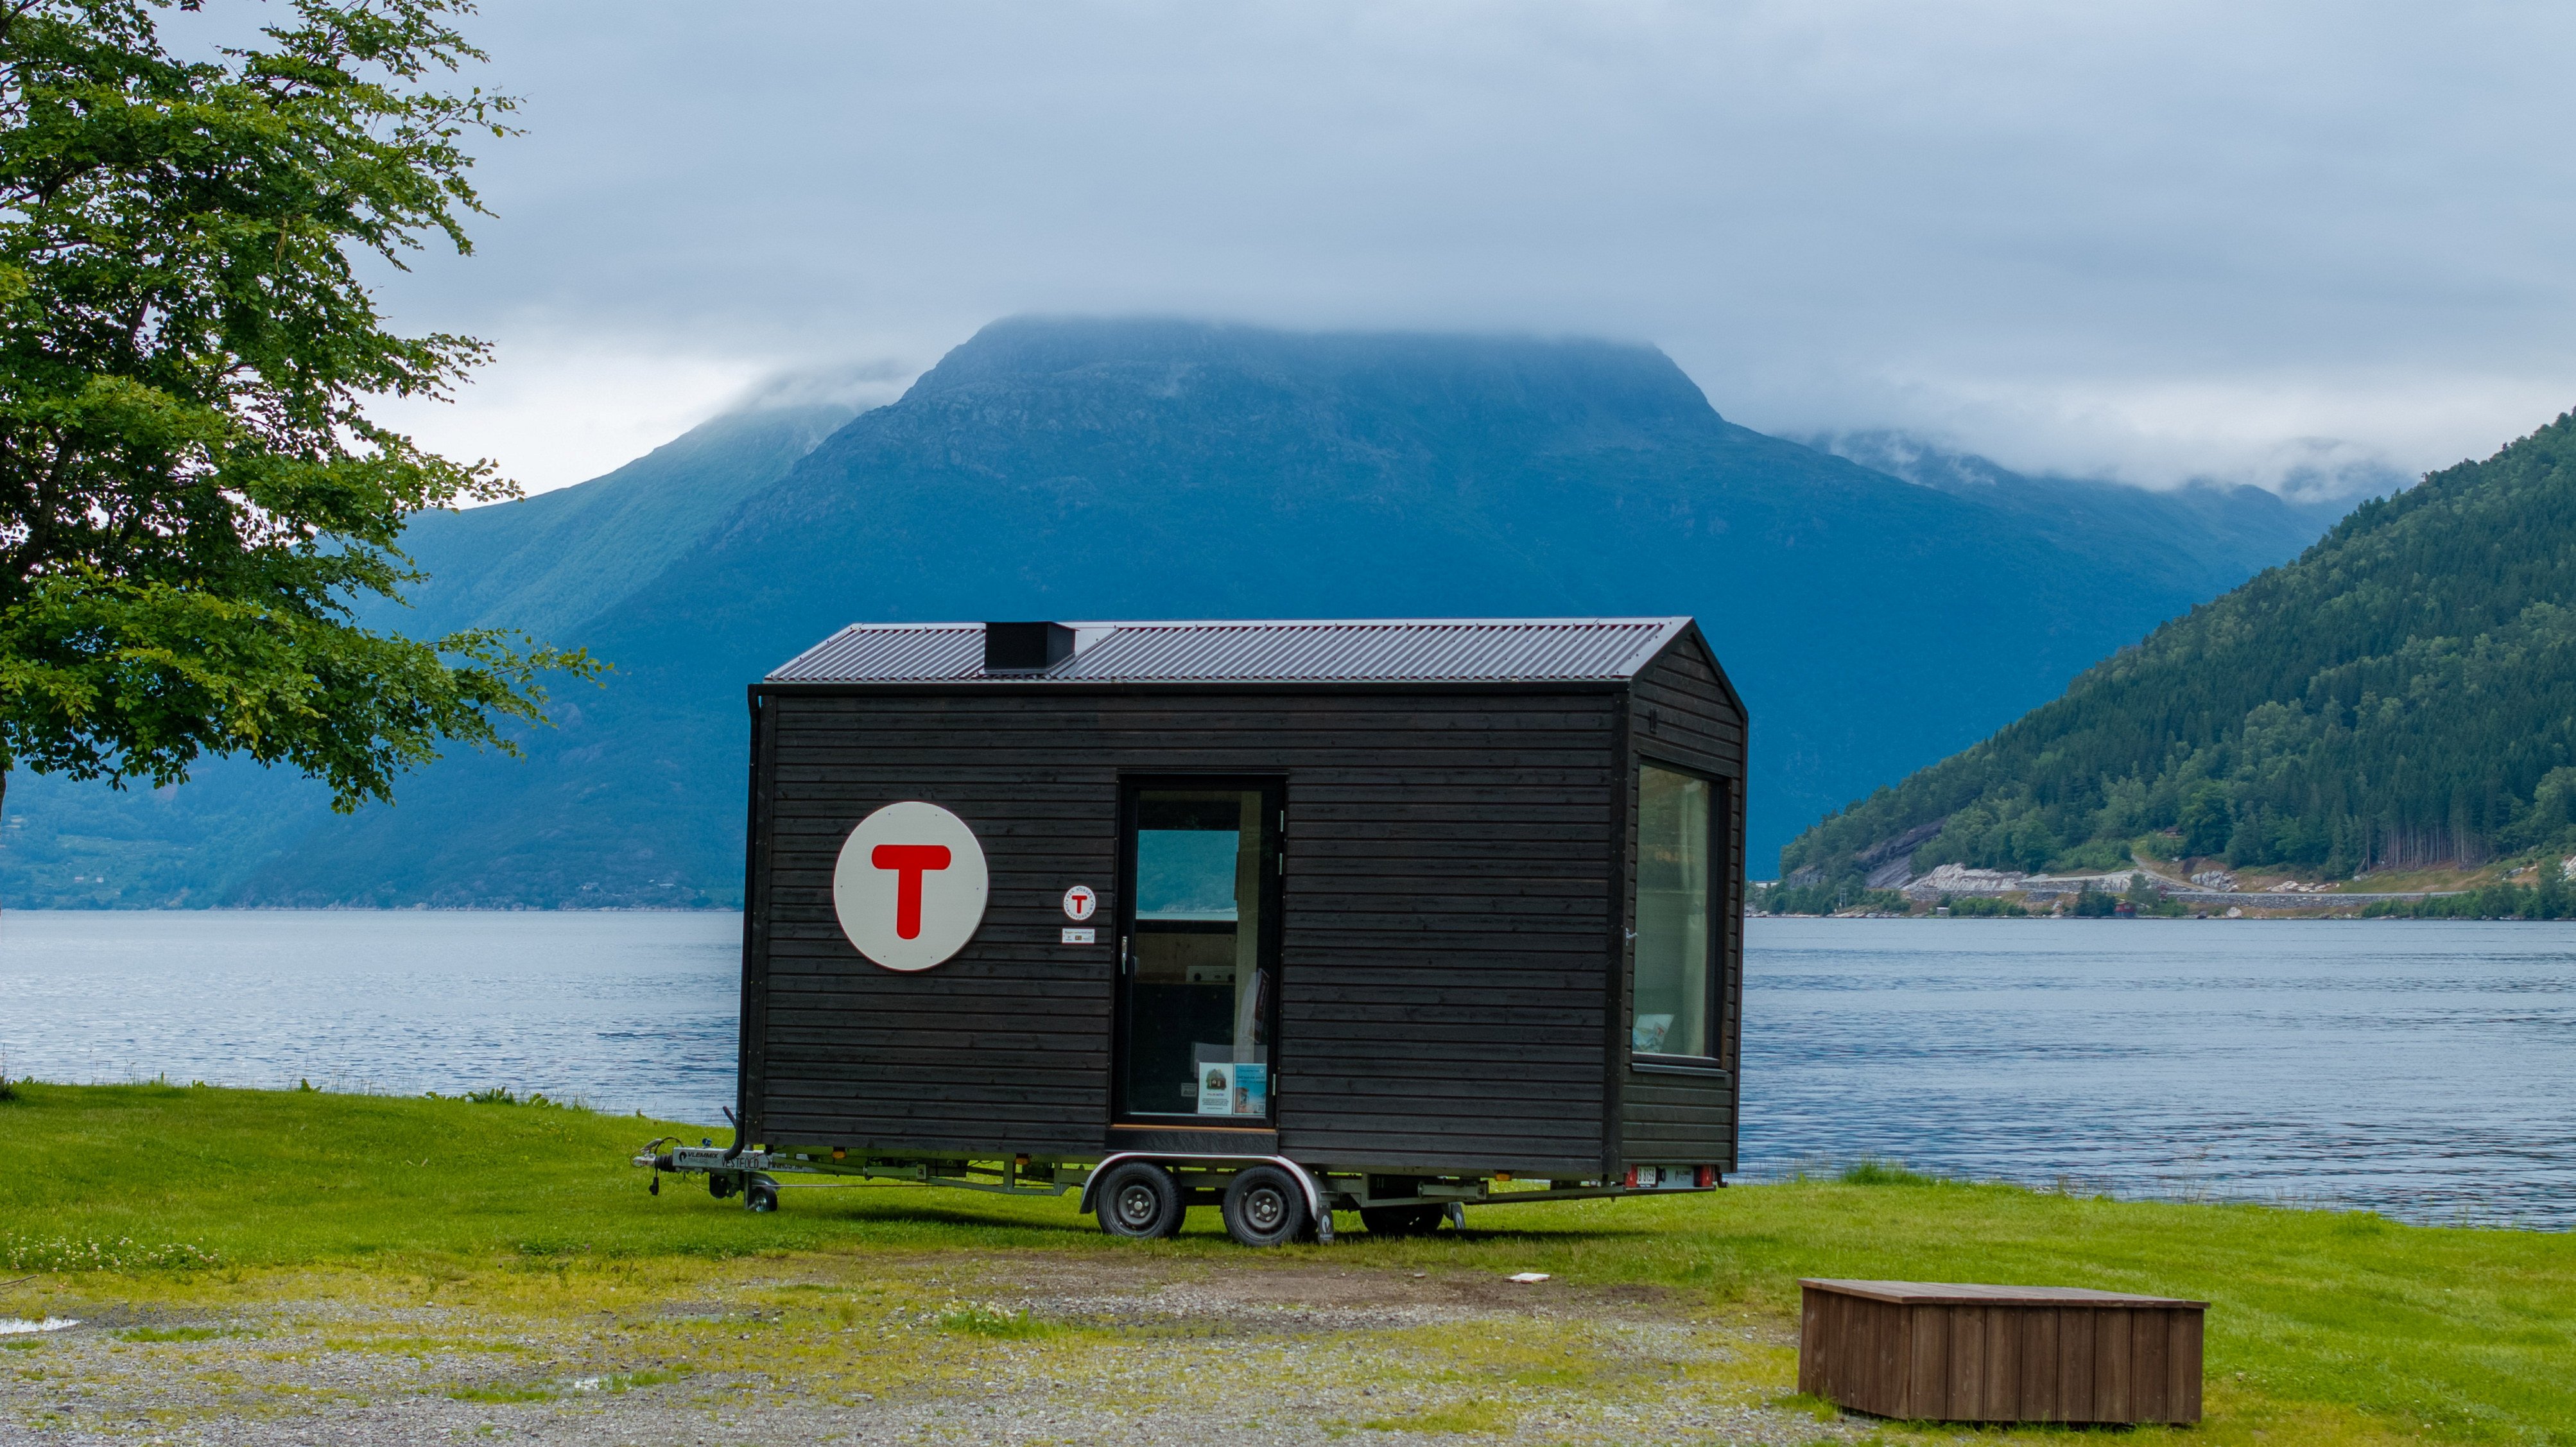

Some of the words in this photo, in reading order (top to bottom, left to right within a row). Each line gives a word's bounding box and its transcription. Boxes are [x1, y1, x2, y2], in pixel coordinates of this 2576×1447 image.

[871, 844, 952, 940] T
[1071, 895, 1088, 914] T
[721, 1156, 759, 1169] VESTFOLD
